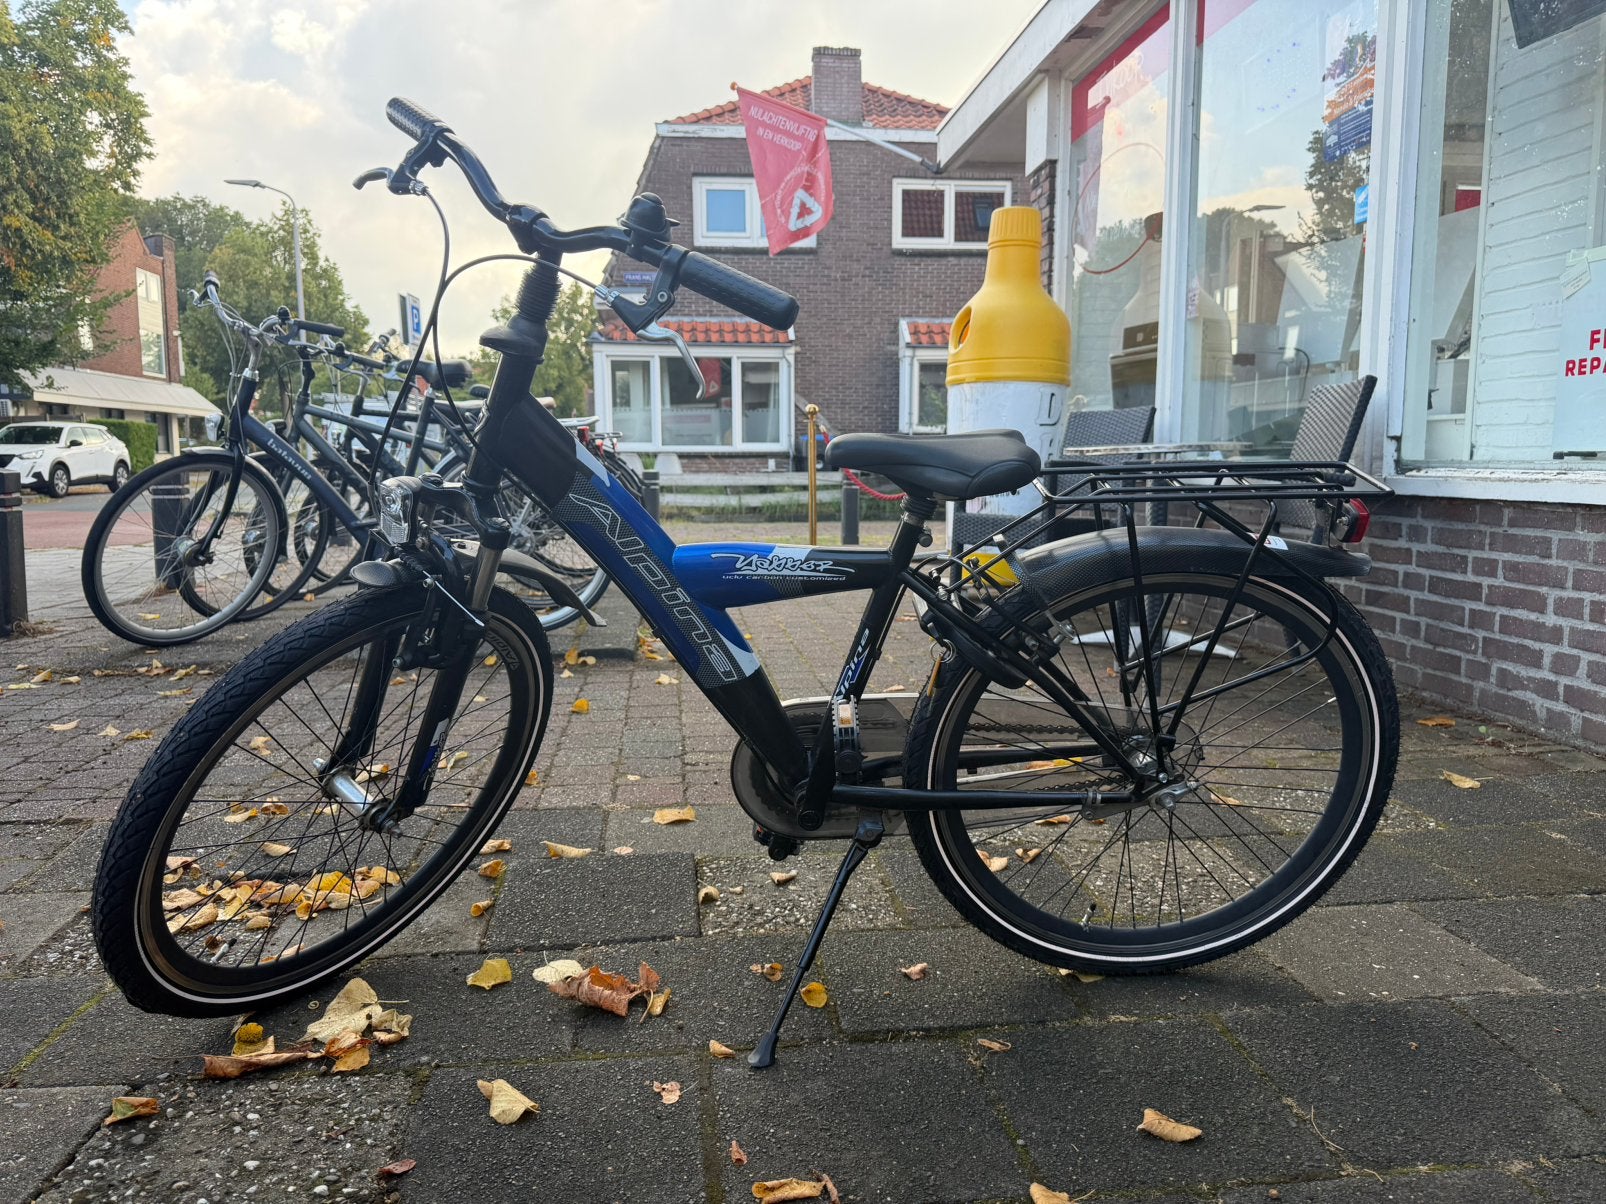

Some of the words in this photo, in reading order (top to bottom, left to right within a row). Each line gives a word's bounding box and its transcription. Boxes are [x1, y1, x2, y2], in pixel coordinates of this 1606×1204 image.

[412, 308, 419, 330] P
[1565, 357, 1606, 377] REP
[568, 492, 738, 683] Alpina
